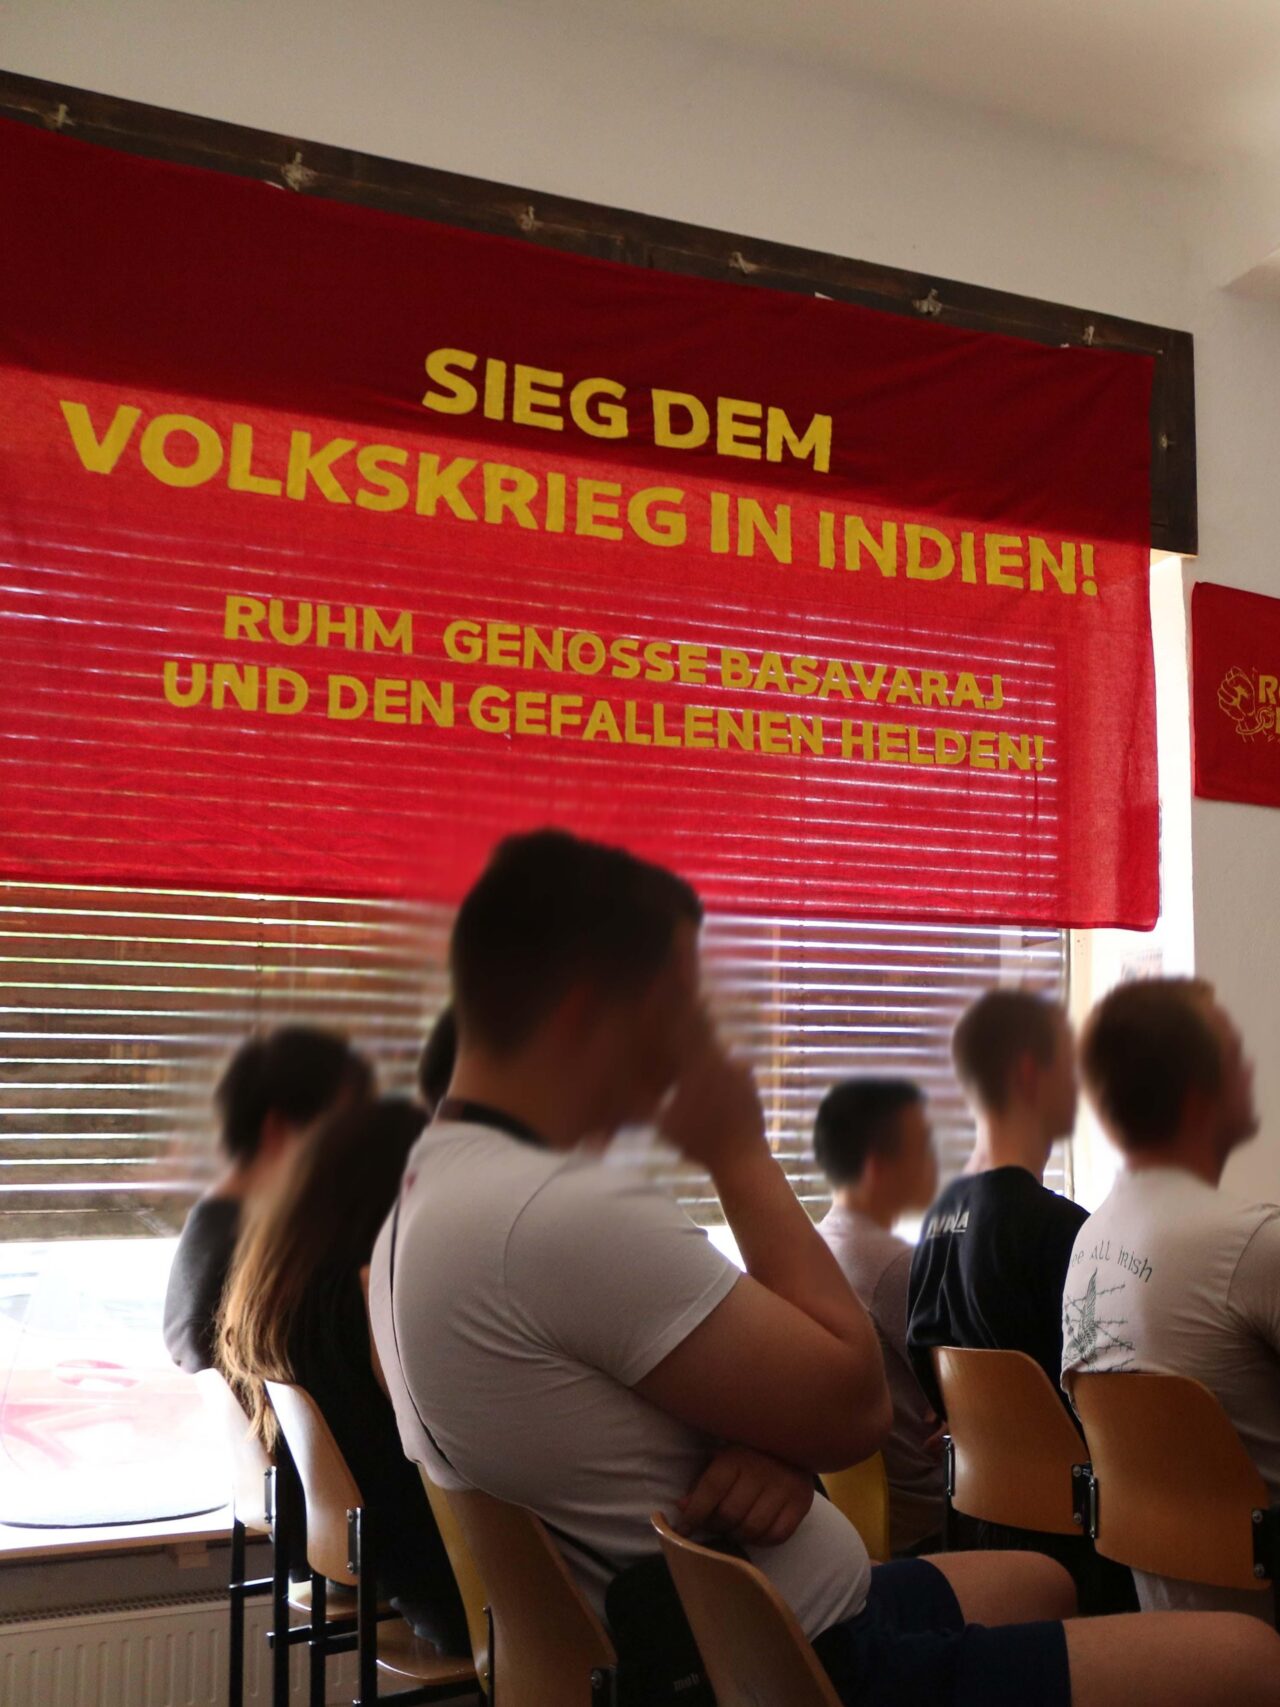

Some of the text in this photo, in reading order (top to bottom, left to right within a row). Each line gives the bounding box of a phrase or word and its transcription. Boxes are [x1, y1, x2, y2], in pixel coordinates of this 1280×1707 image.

[423, 348, 832, 472] SIEG DEM
[60, 401, 1098, 596] VOLKSKRIEG IN INDIEN!
[223, 595, 1003, 710] RUHM GENOSSE BASAVARAJ
[163, 662, 1044, 771] UND DEN GEFALLENEN HELDEN!
